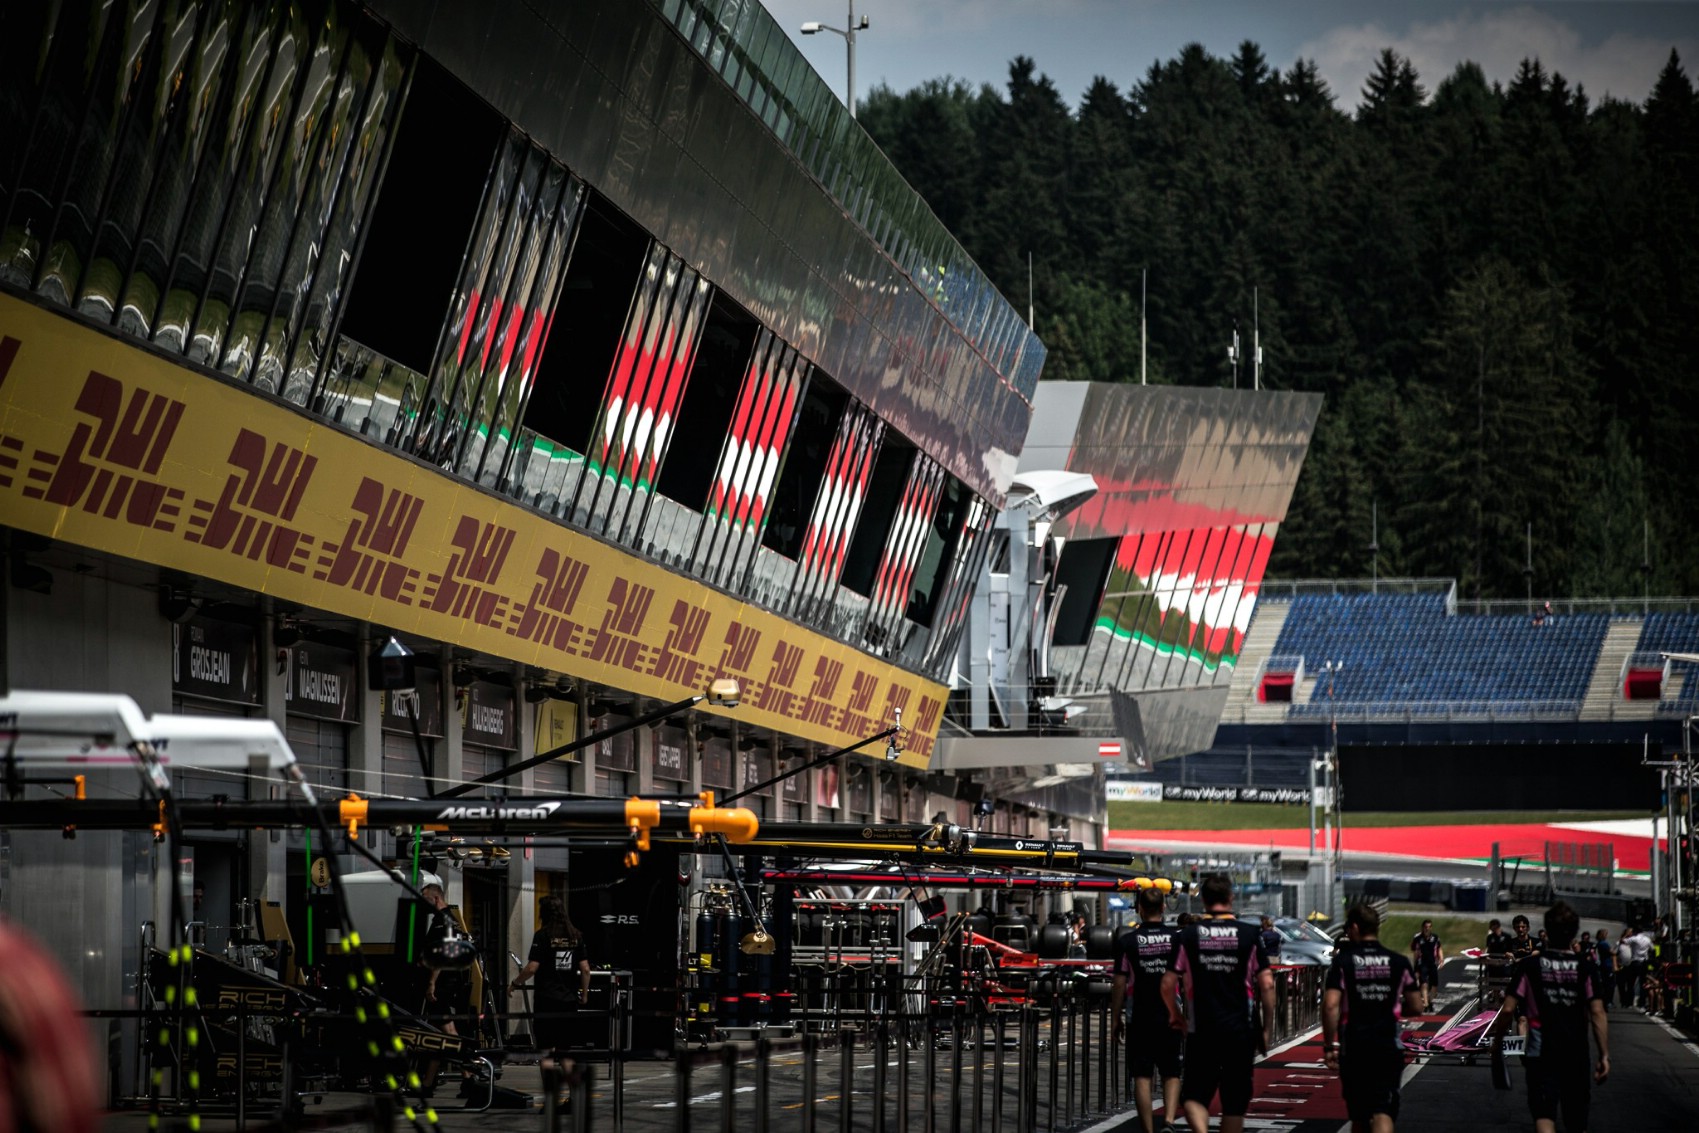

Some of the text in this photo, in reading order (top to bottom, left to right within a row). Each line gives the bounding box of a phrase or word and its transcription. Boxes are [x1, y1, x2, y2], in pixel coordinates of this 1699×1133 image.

[44, 370, 186, 527] DHL
[202, 428, 318, 569] DHL
[327, 477, 424, 599] DHL
[431, 515, 516, 625] DHL
[515, 547, 590, 651] DHL
[589, 576, 655, 670] DHL
[191, 645, 230, 685] GROSJEAN
[653, 599, 711, 687] DHL
[300, 667, 340, 705] MAGNUSSEN
[758, 640, 805, 717] DHL
[800, 655, 844, 728] DHL
[839, 671, 879, 738] DHL
[1183, 787, 1237, 801] myWorld
[1147, 934, 1172, 944] BWT
[1211, 926, 1239, 937] BWT
[219, 991, 286, 1005] RICH
[217, 1058, 285, 1070] RCH
[398, 1030, 463, 1053] RICH
[1501, 1040, 1523, 1050] BWT
